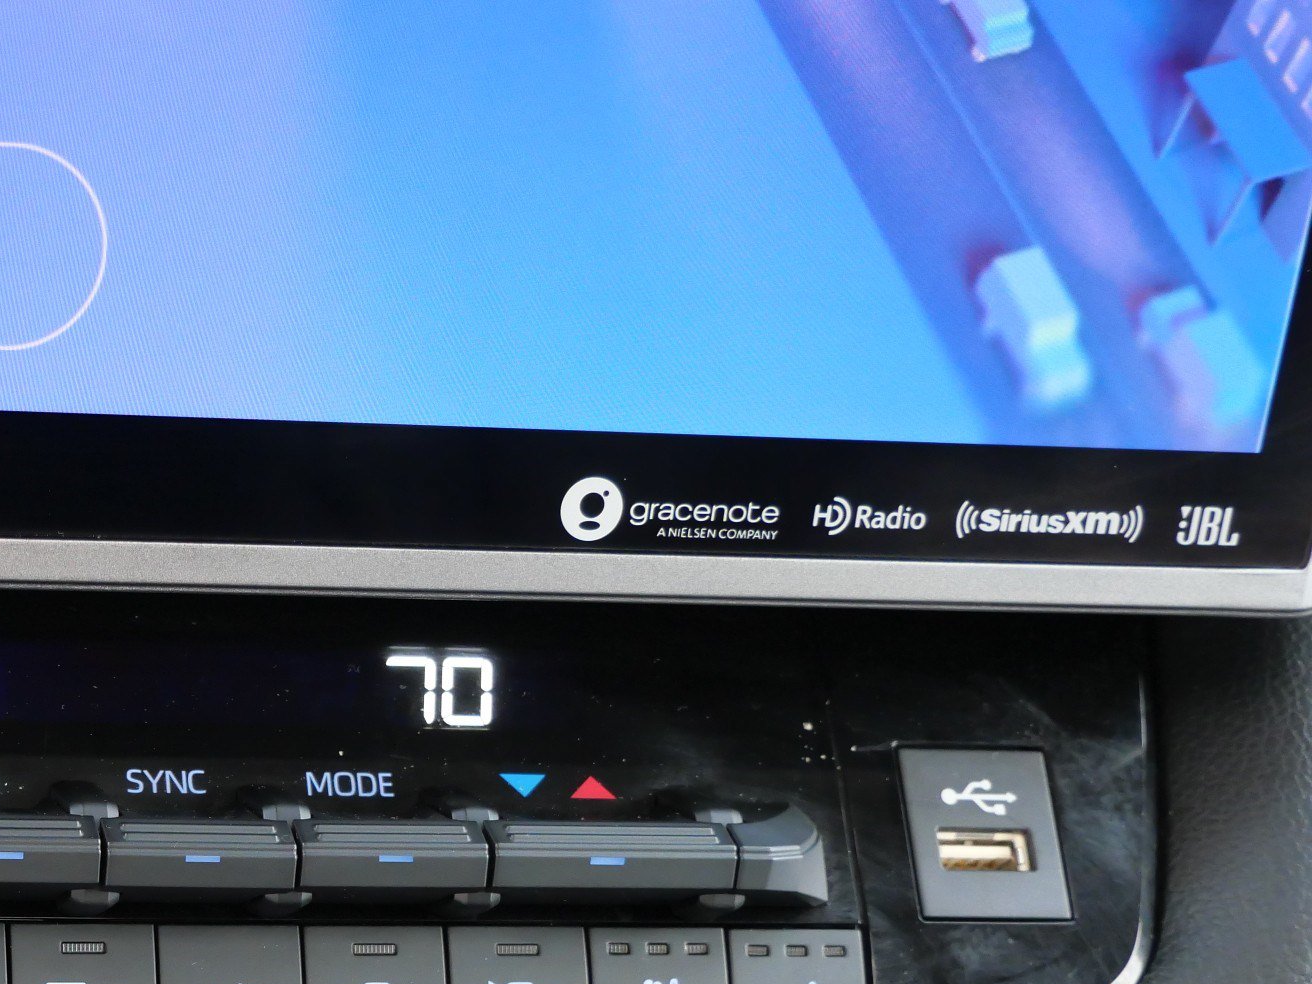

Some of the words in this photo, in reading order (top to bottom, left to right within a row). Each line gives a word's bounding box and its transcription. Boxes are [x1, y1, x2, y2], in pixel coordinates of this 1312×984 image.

[628, 500, 780, 527] gracenote
[854, 503, 928, 530] Radio
[1175, 505, 1240, 547] JBL
[656, 527, 666, 538] A
[667, 527, 717, 539] NIELSEN
[718, 528, 779, 540] COMPANY
[385, 655, 495, 727] 70
[125, 768, 207, 795] SYNC
[305, 771, 395, 798] MODE
